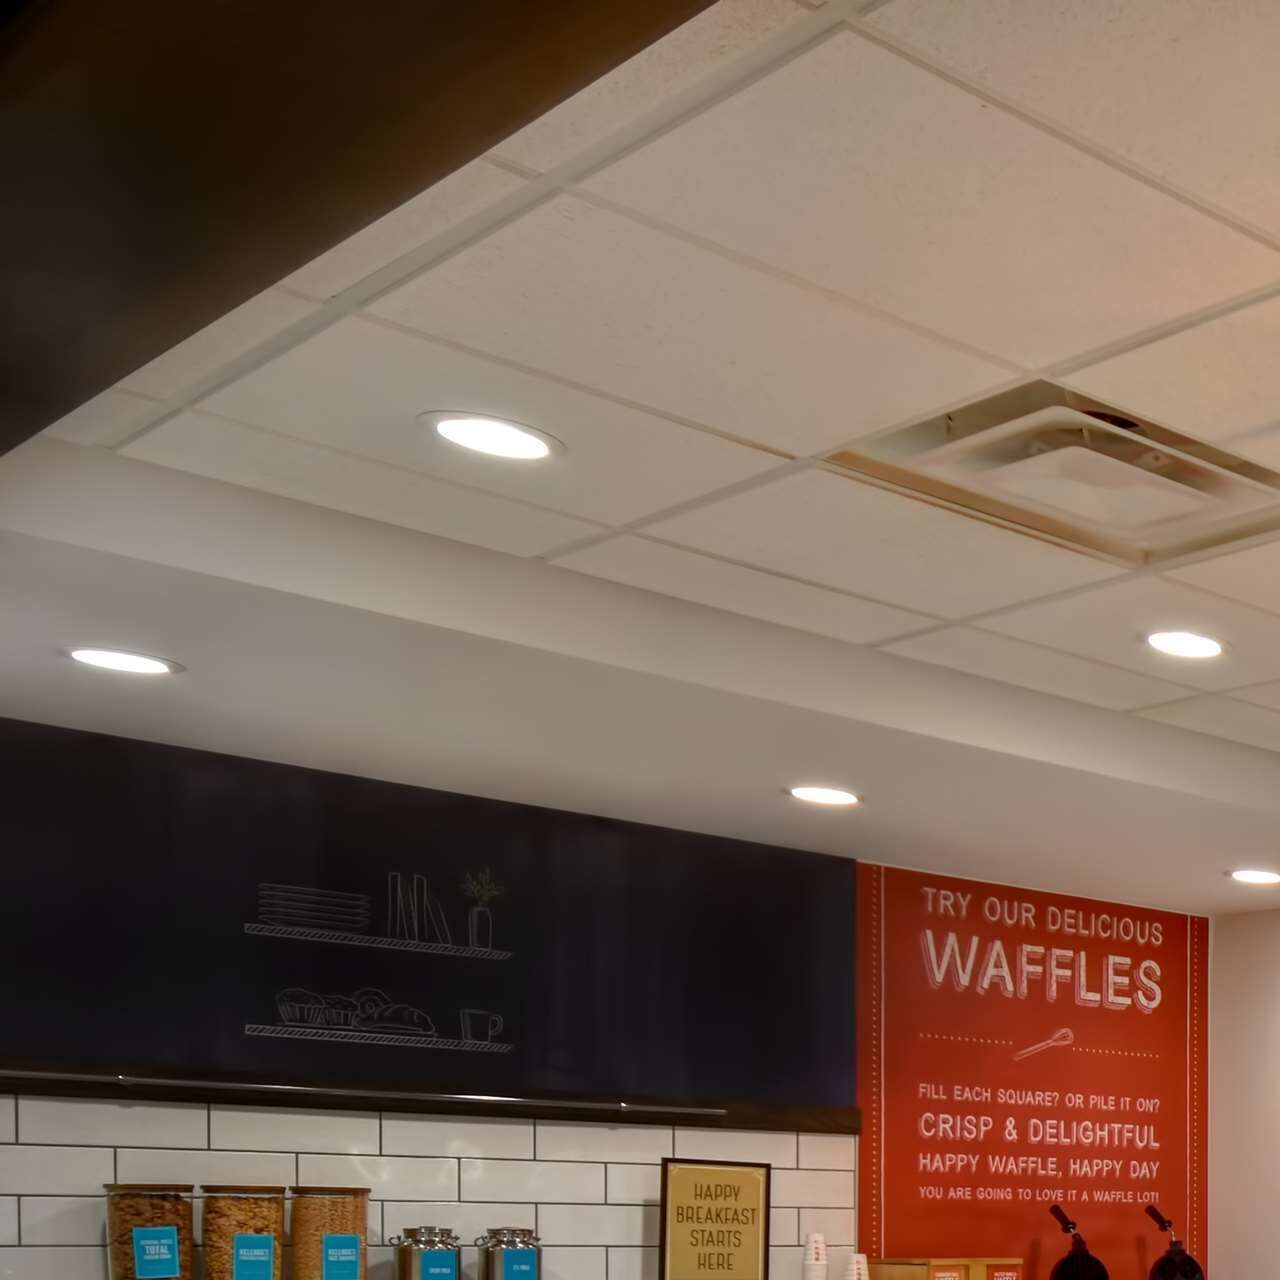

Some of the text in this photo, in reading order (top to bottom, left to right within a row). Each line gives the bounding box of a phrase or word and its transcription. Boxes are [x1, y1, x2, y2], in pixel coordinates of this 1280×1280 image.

[922, 887, 1164, 946] TRY OUR DELICIOUS
[920, 928, 1163, 1014] WAFFLES
[919, 1083, 1161, 1112] FILL EACH SQUARE? OR PILE IT ON?
[919, 1112, 1160, 1149] CRISP & DELIGHTFUL
[919, 1152, 1160, 1179] HAPPY WAFFLE, HAPPY DAY
[694, 1184, 741, 1201] HAPPY
[919, 1185, 1160, 1203] YOU ARE GOING TO LOVE IT A WAFFLE LOT!
[676, 1206, 758, 1226] BREAKFAST
[690, 1229, 742, 1248] STARTS
[144, 1245, 169, 1255] TOTAL
[697, 1253, 734, 1271] HERE
